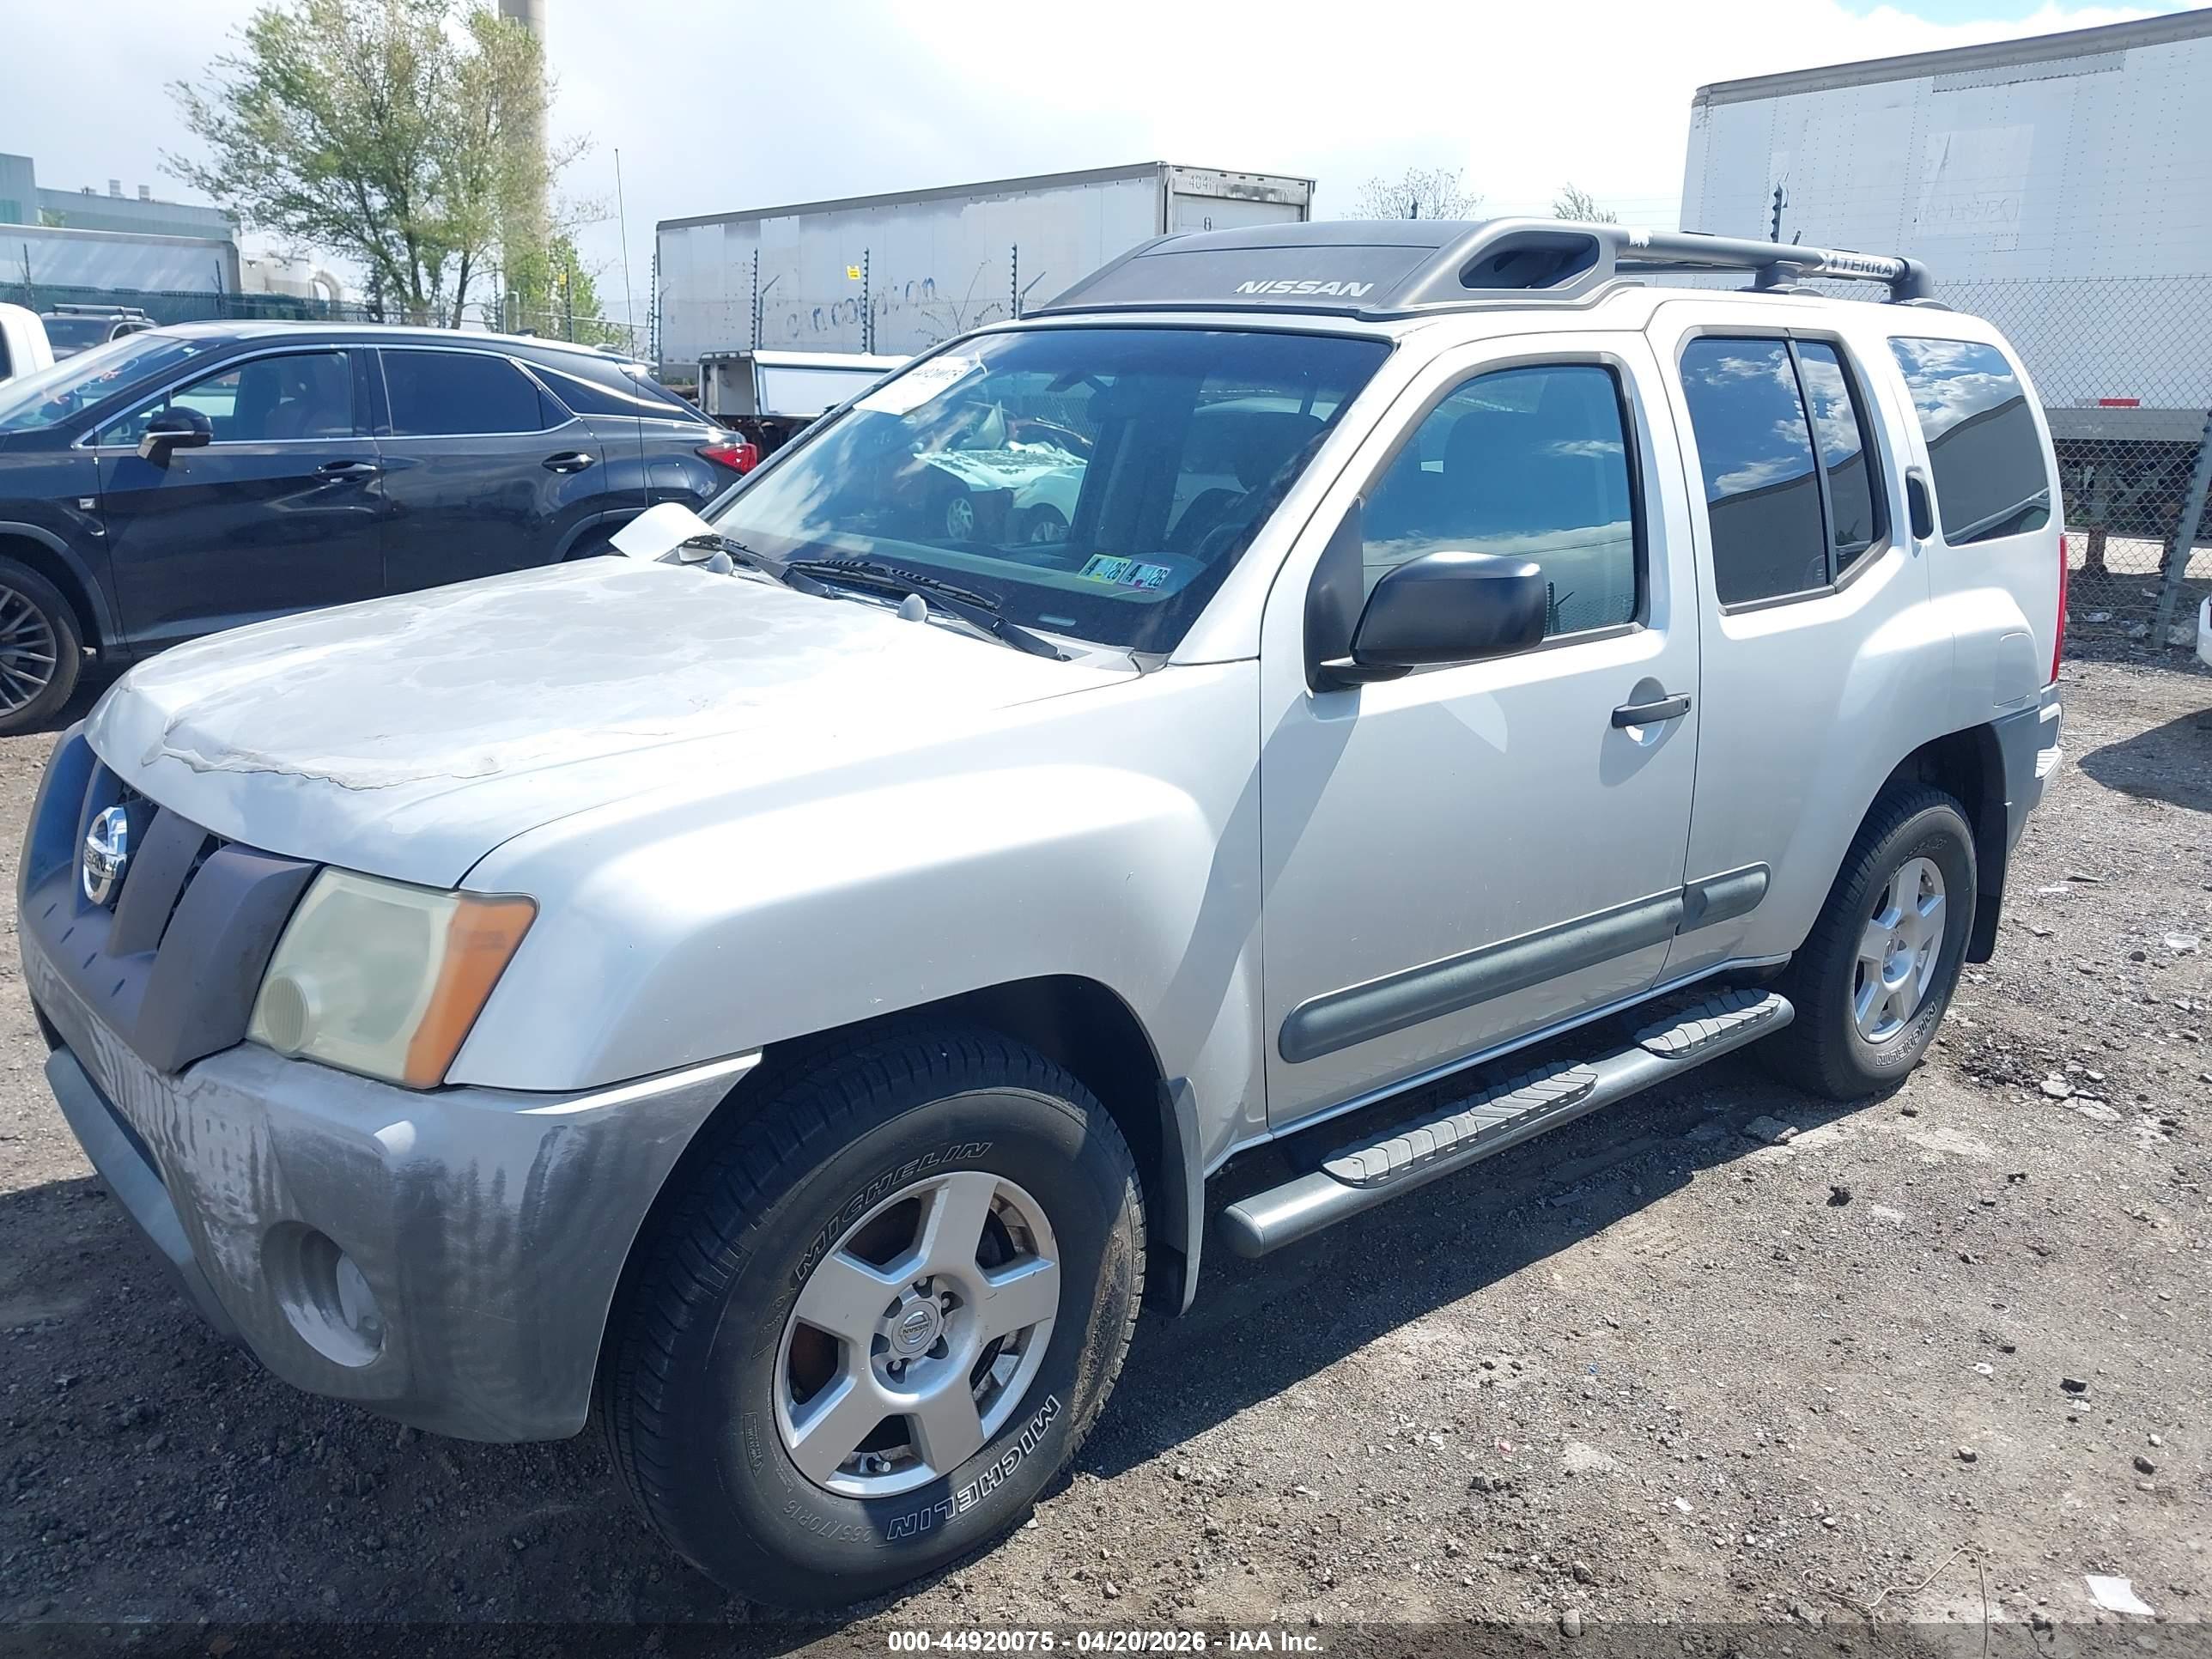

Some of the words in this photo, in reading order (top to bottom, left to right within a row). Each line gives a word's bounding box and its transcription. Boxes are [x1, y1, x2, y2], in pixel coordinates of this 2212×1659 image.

[1234, 279, 1375, 298] NISSAN
[1876, 1000, 1938, 1066] MICHELIN
[795, 1141, 993, 1281] MICHELIN
[886, 1394, 1060, 1540] MICHELIN
